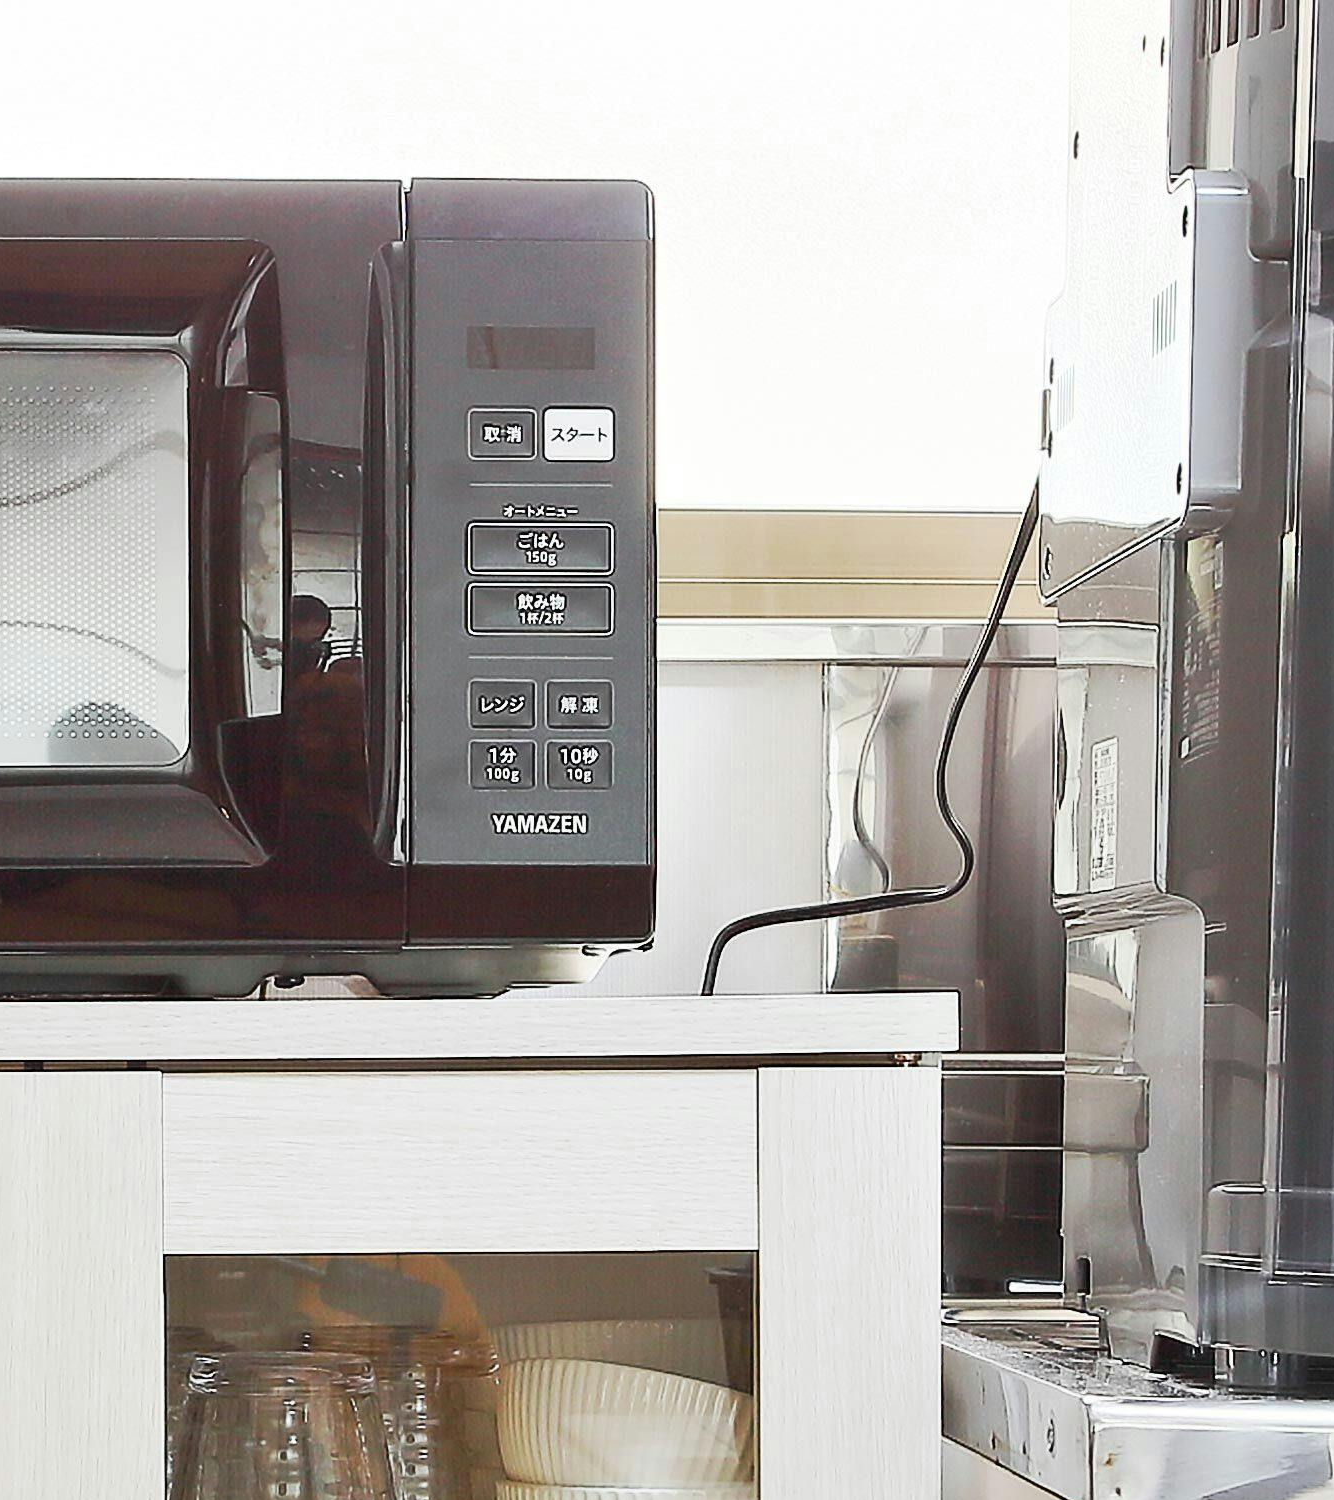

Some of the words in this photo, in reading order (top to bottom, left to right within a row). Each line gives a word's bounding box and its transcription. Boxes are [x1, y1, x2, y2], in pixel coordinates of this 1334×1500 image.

[551, 427, 608, 443] スタート
[503, 504, 579, 518] オートメニュー
[518, 532, 565, 549] ごはん
[526, 551, 557, 566] 150g
[518, 593, 566, 610] 飲み物
[520, 612, 565, 625] 1杯/2杯
[480, 696, 525, 713] レンジ
[560, 696, 599, 714] 解凍
[489, 747, 517, 764] 1分
[560, 747, 599, 765] 10秒
[486, 768, 520, 783] 100g
[567, 768, 592, 783] 10g
[492, 814, 587, 834] YAMAZEN
